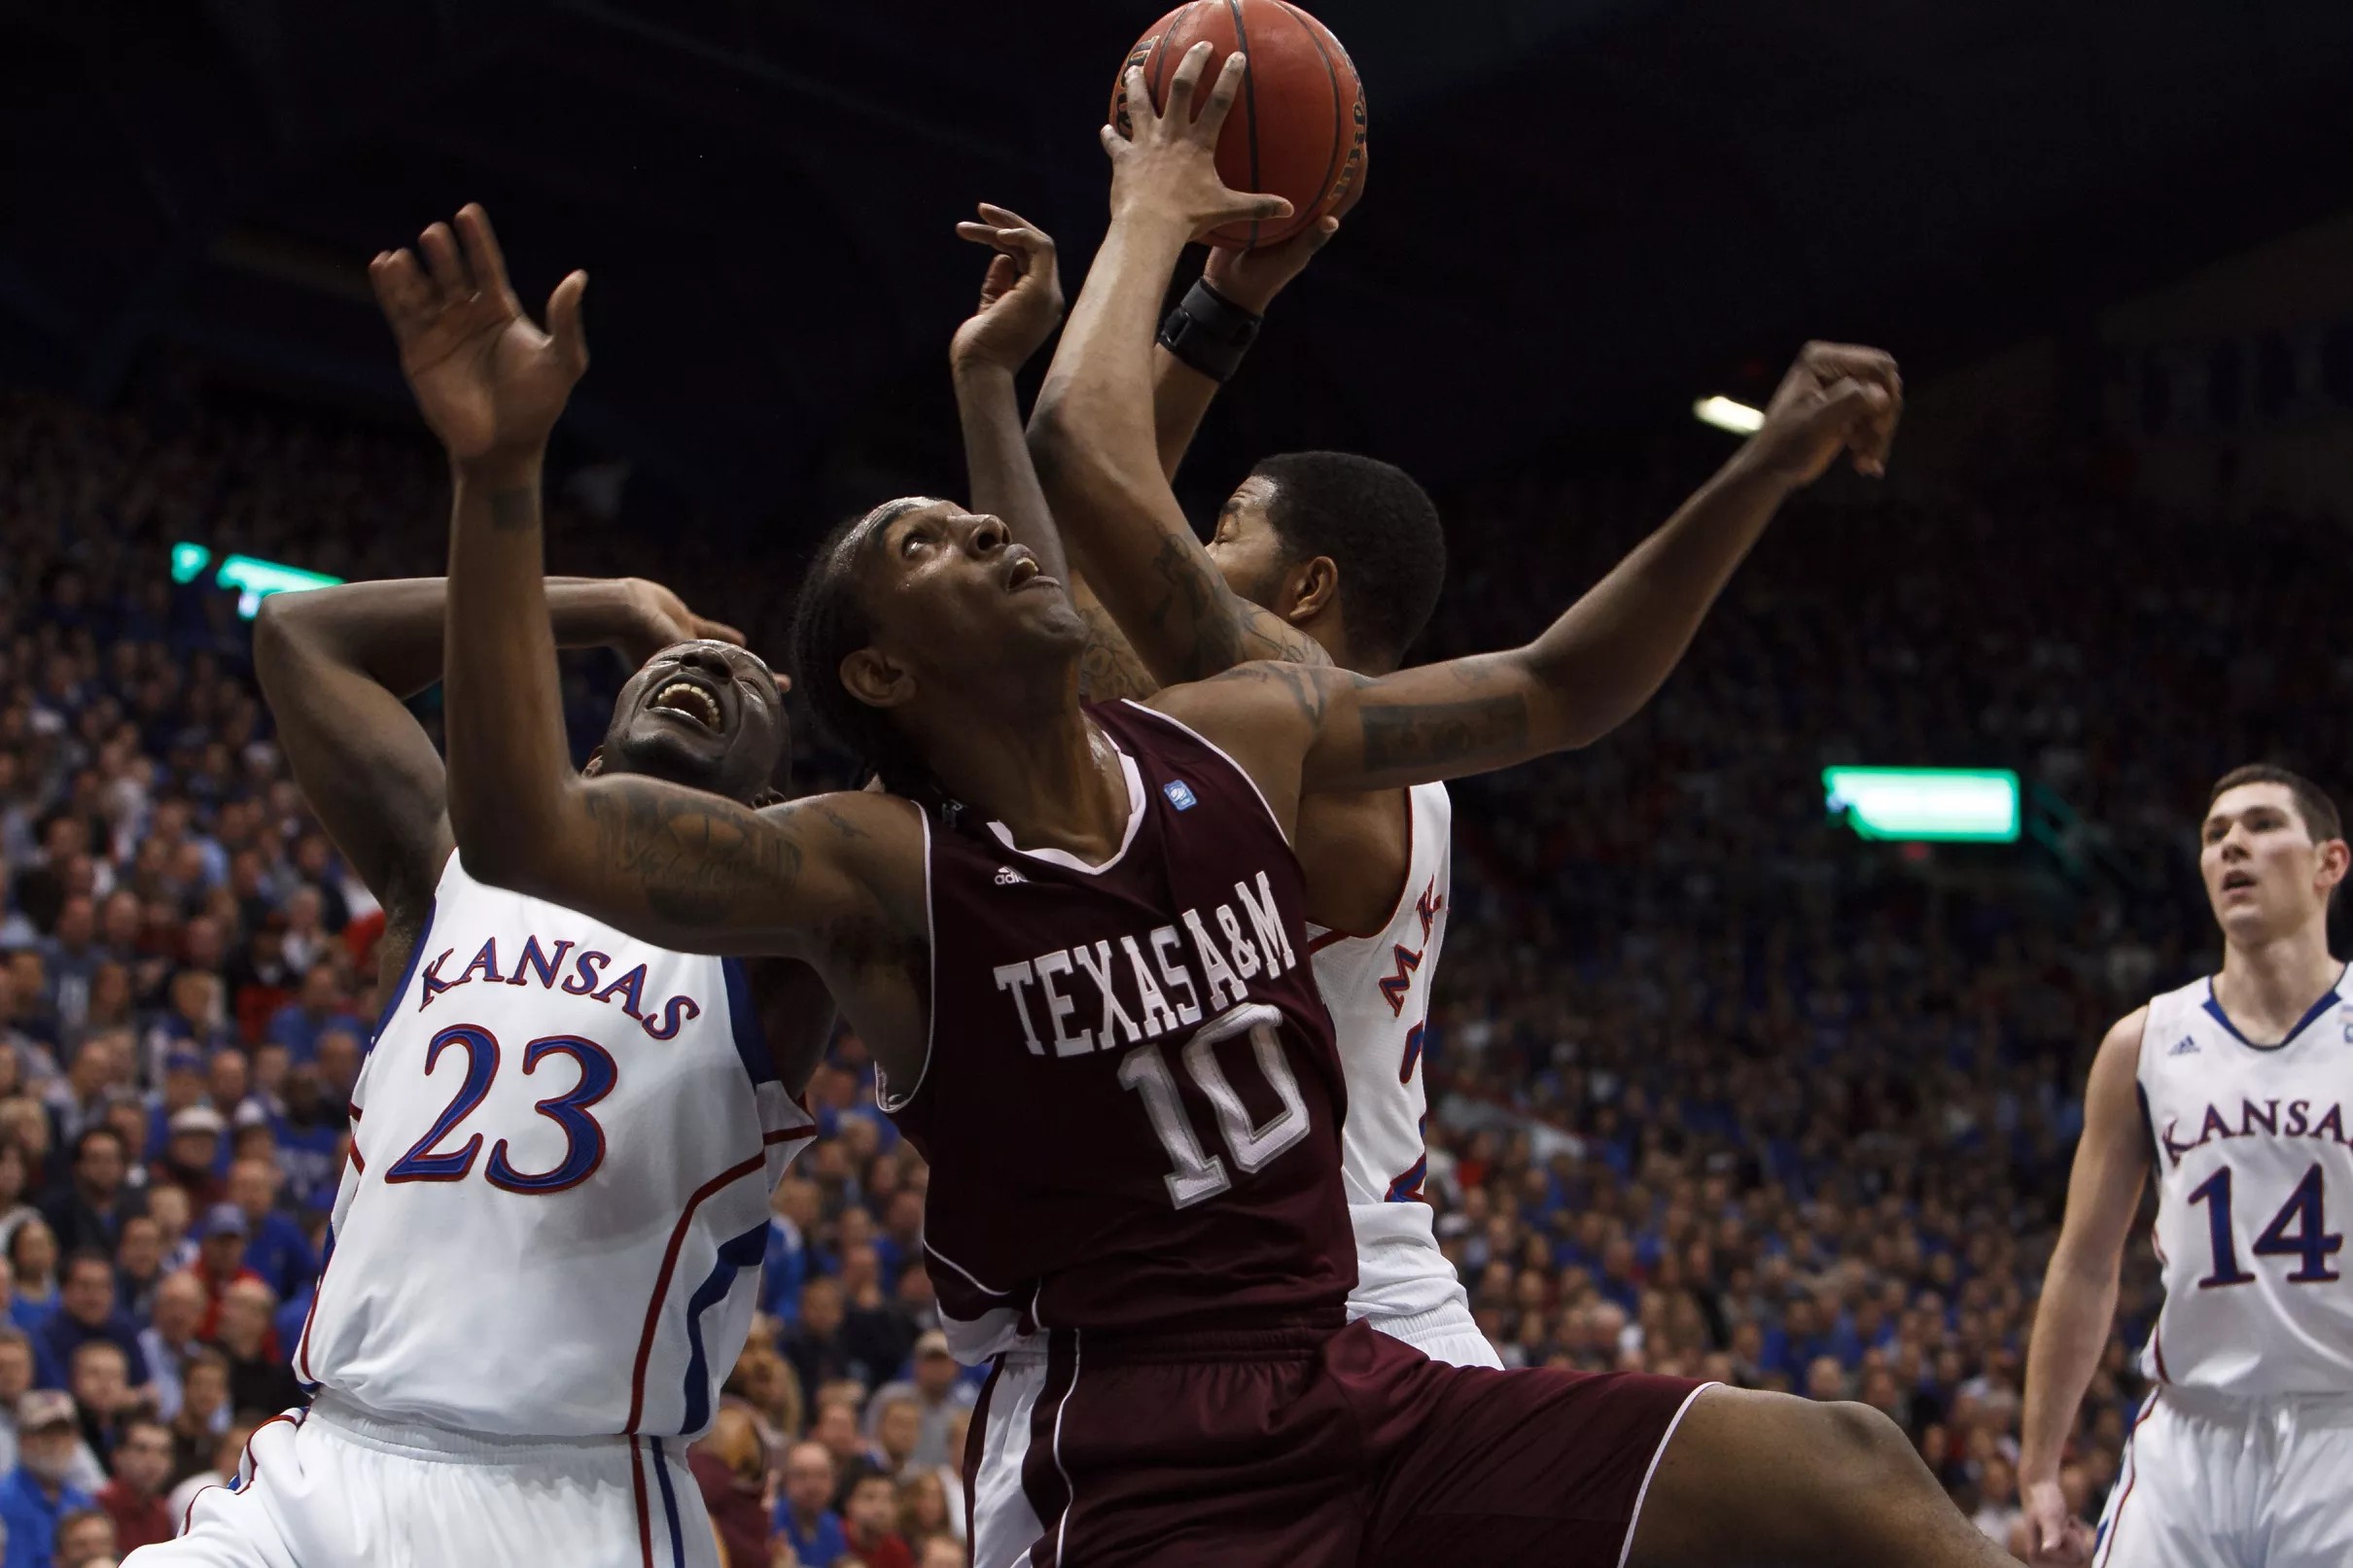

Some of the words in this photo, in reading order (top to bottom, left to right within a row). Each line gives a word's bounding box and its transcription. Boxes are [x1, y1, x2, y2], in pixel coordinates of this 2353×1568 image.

[418, 934, 700, 1041] KANSAS
[993, 924, 1202, 1058] TEXAS
[1181, 870, 1296, 1011] A&M
[384, 1023, 618, 1195] 23
[1117, 1002, 1310, 1210] 10
[2161, 1097, 2353, 1168] KANSA
[2188, 1163, 2344, 1290] 14
